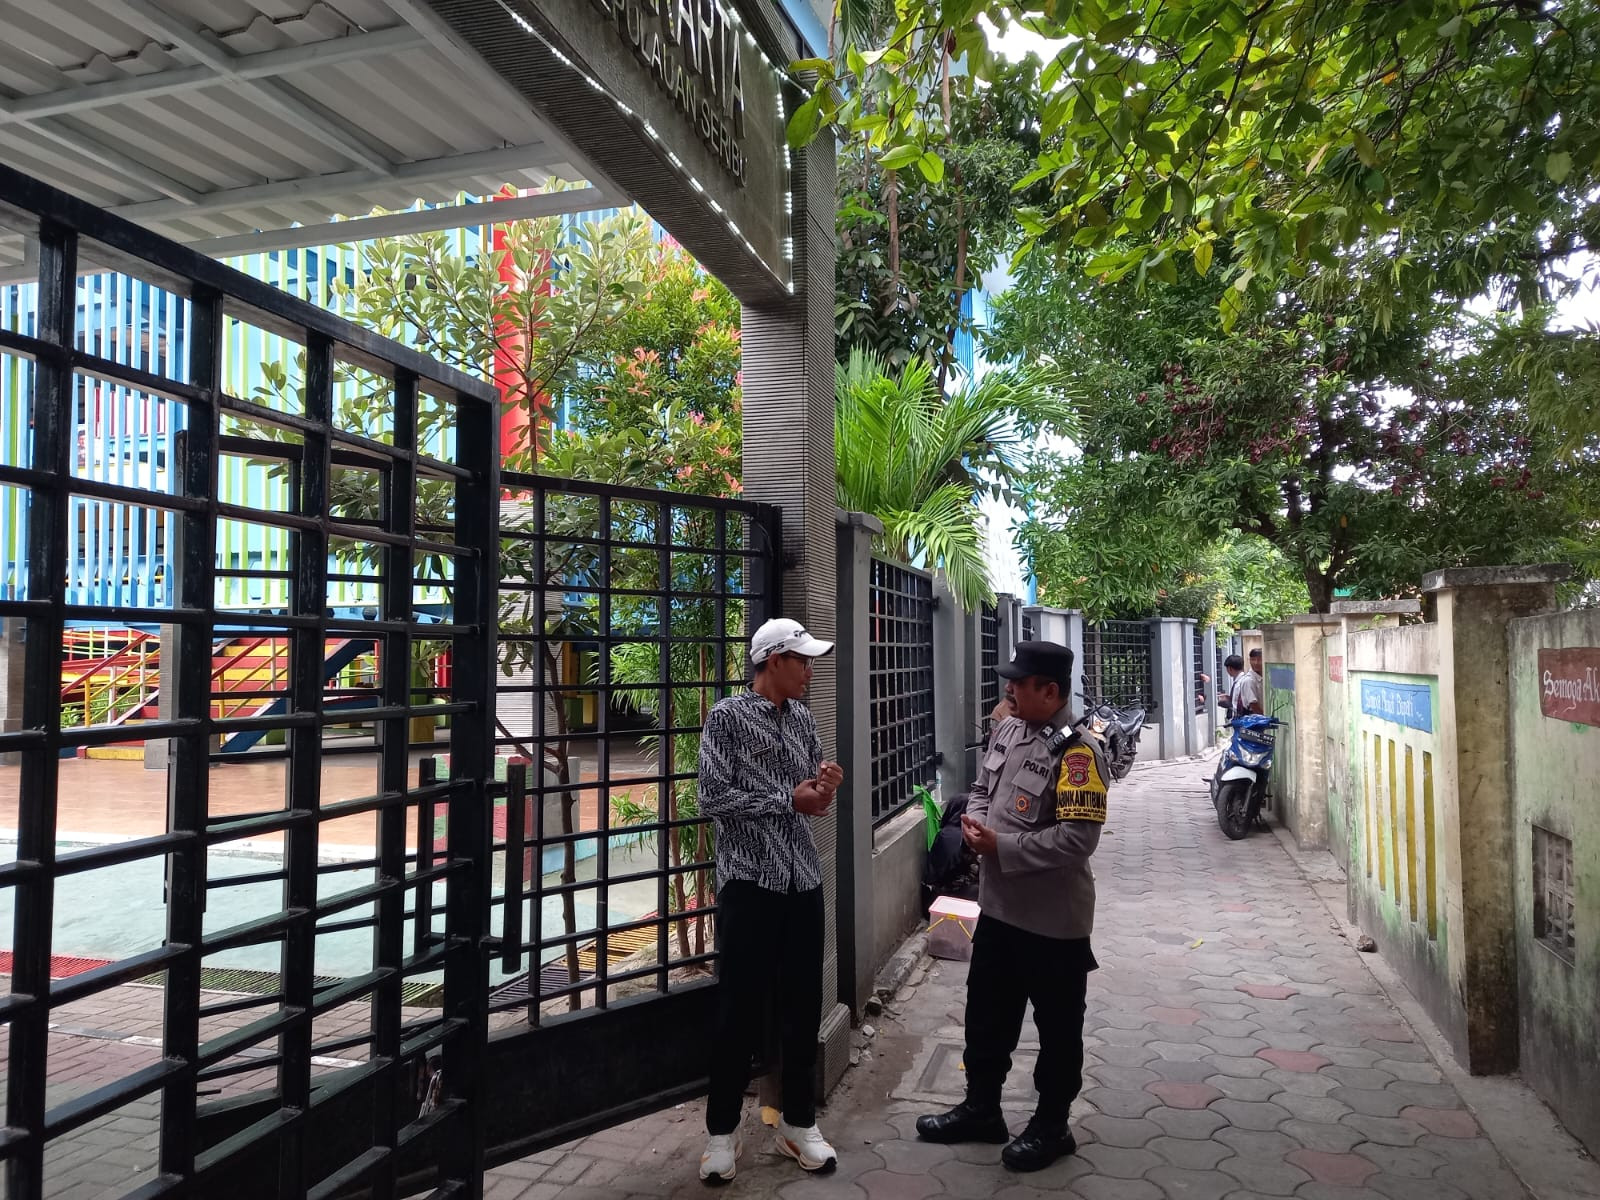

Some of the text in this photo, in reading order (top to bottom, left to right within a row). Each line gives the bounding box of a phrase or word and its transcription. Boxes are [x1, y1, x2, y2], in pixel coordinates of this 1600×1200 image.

[600, 0, 748, 188] PULAUAN SERIBU
[1543, 669, 1583, 712] Semoga
[1023, 759, 1050, 778] POLRI
